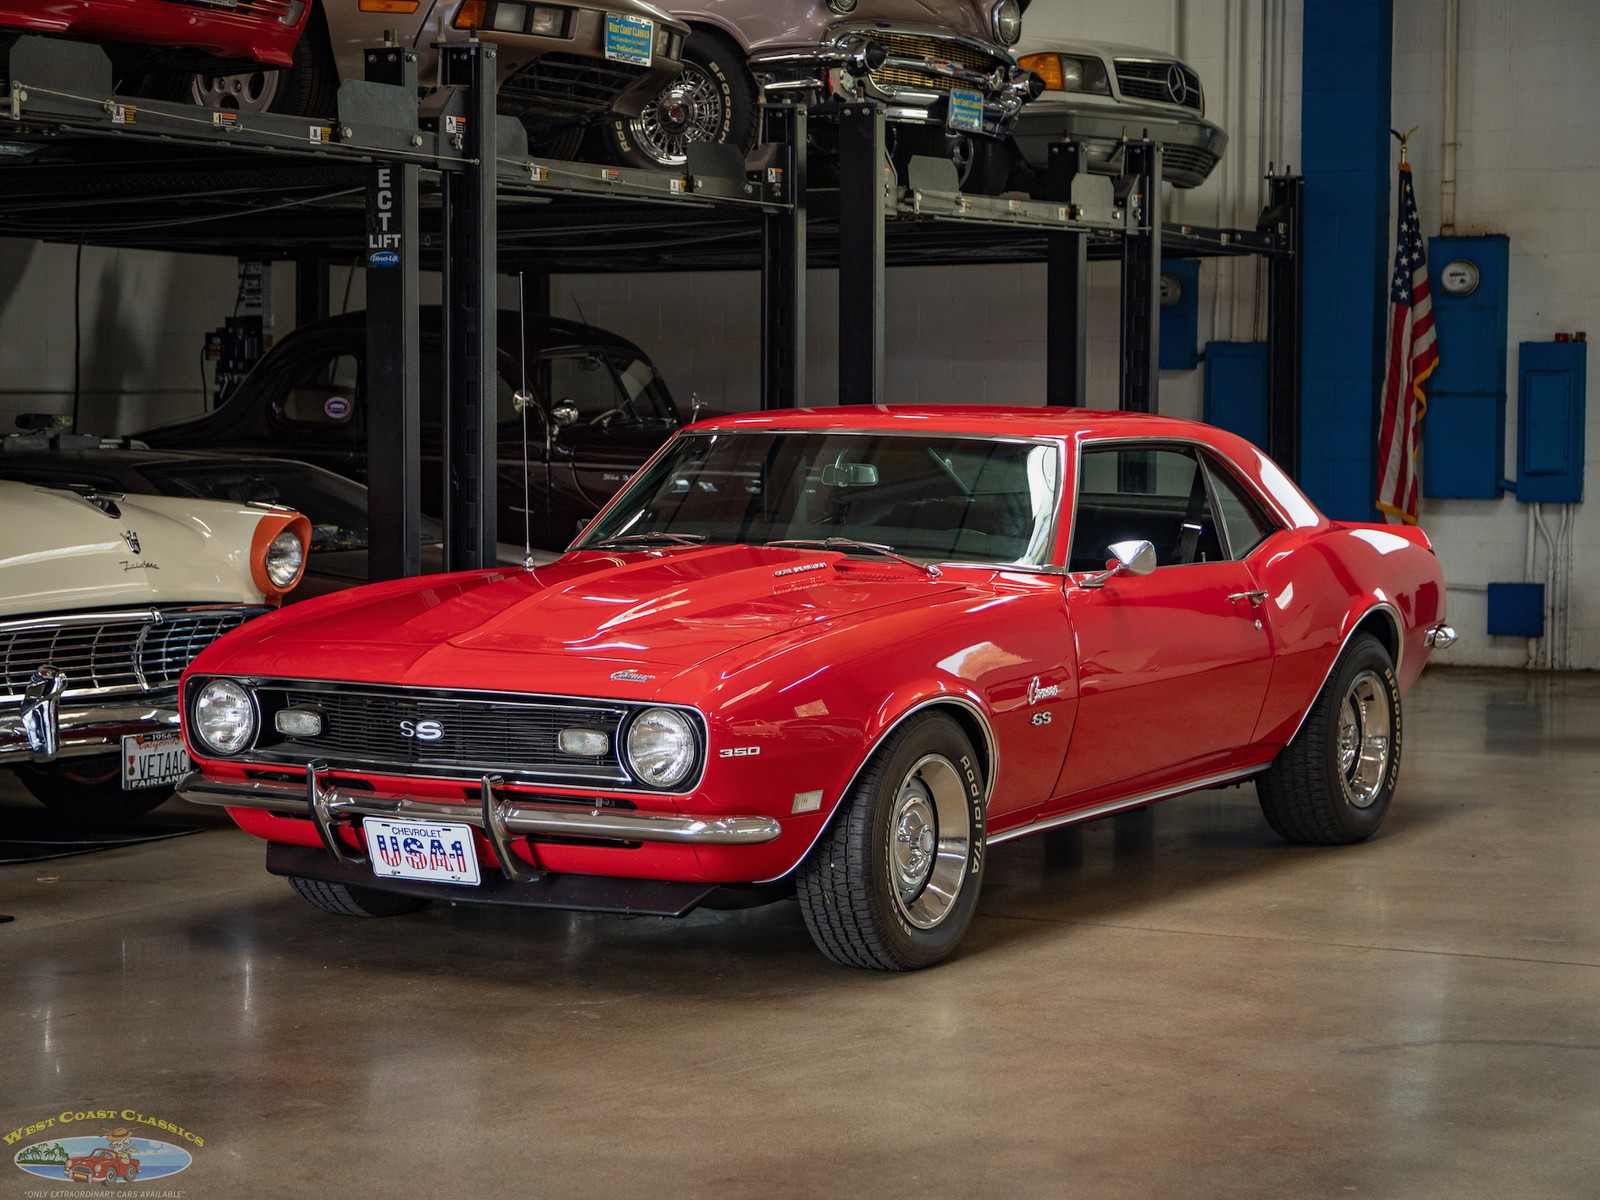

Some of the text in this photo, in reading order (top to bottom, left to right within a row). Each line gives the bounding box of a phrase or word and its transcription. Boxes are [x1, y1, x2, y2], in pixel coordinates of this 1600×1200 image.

[369, 233, 401, 248] LIFT
[1031, 711, 1052, 726] SS
[152, 732, 172, 741] 1956
[399, 720, 444, 740] SS
[719, 746, 761, 758] 350
[139, 749, 187, 778] VETAAC
[960, 755, 983, 874] Radial T/A
[391, 826, 442, 838] CHEVROLET
